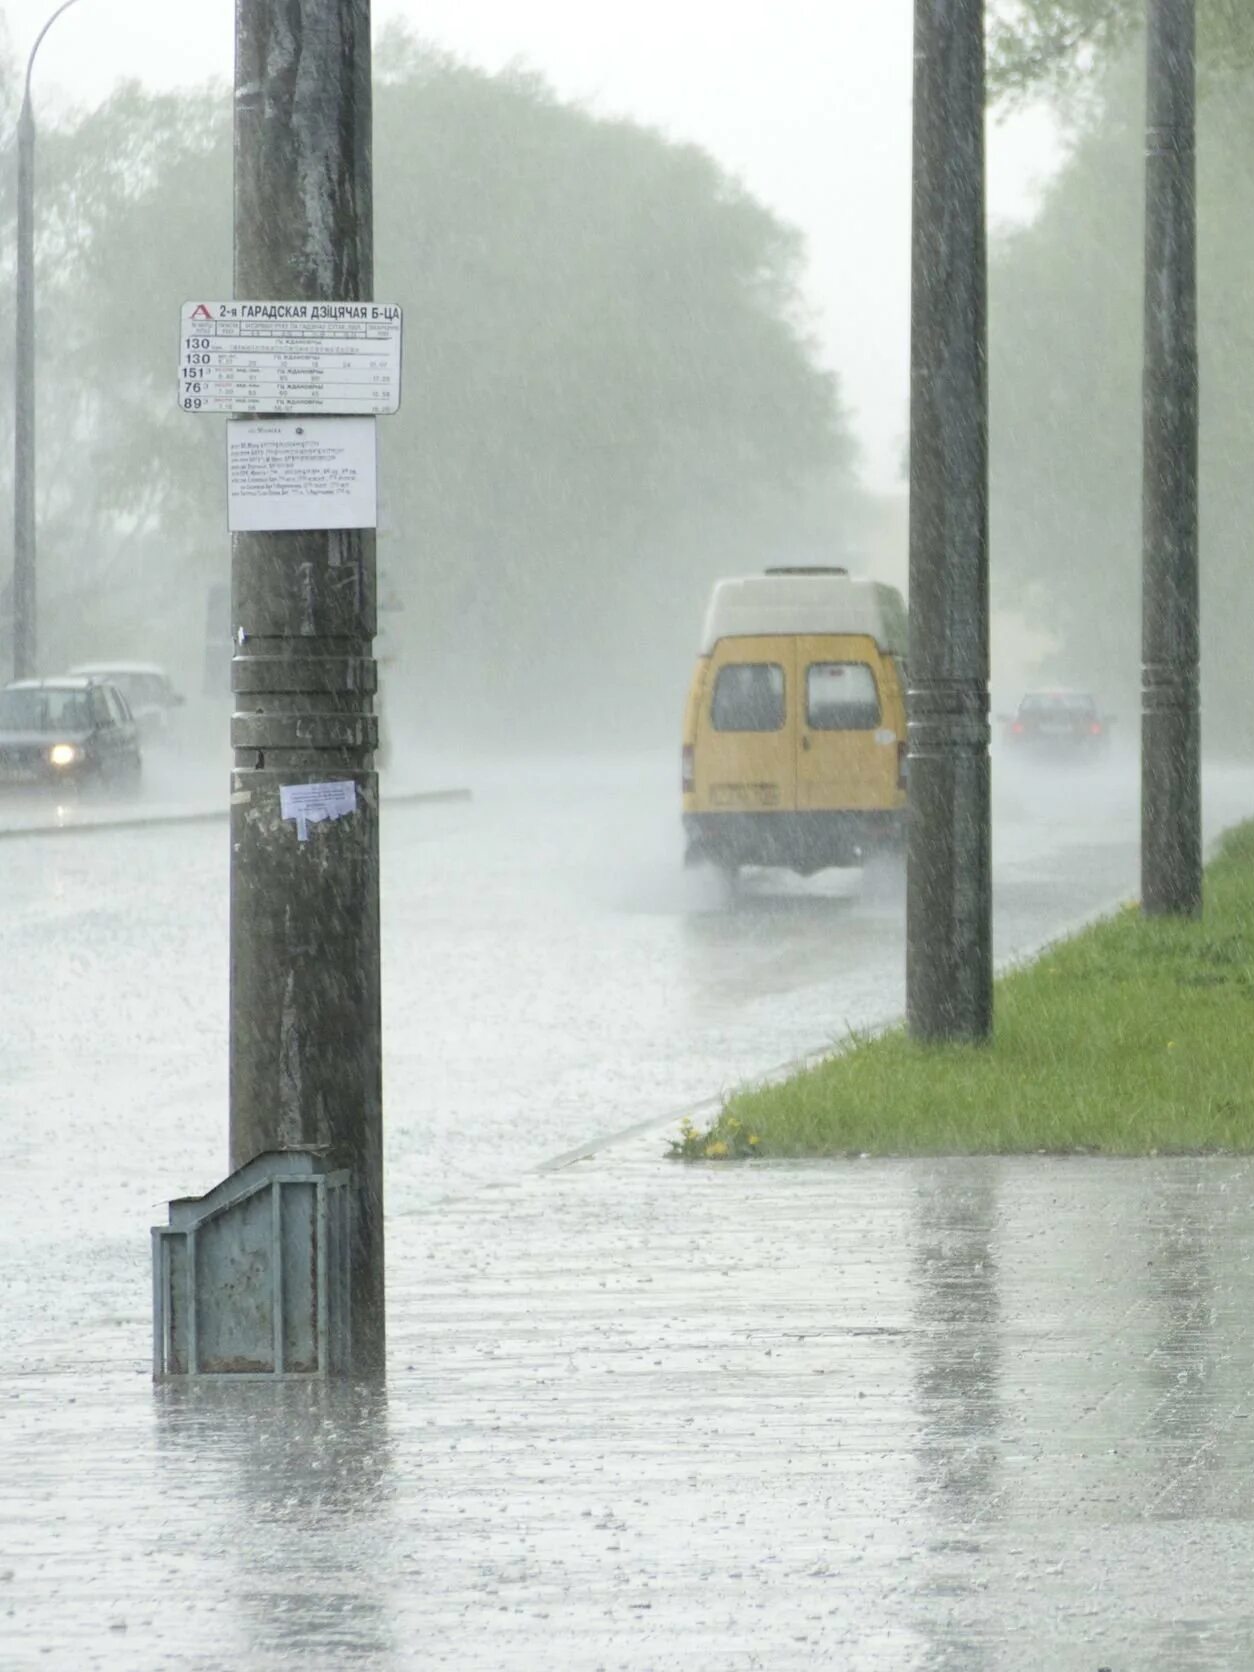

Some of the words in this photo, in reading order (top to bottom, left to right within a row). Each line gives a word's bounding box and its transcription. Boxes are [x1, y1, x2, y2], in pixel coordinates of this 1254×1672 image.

[219, 304, 237, 317] 2-я
[241, 305, 307, 319] ГАРАДСКАЯ
[371, 307, 400, 321] Б-ЦА
[185, 338, 210, 349] 130
[186, 353, 211, 364] 130
[182, 367, 204, 378] 151
[185, 382, 201, 393] 76
[184, 398, 202, 409] 89
